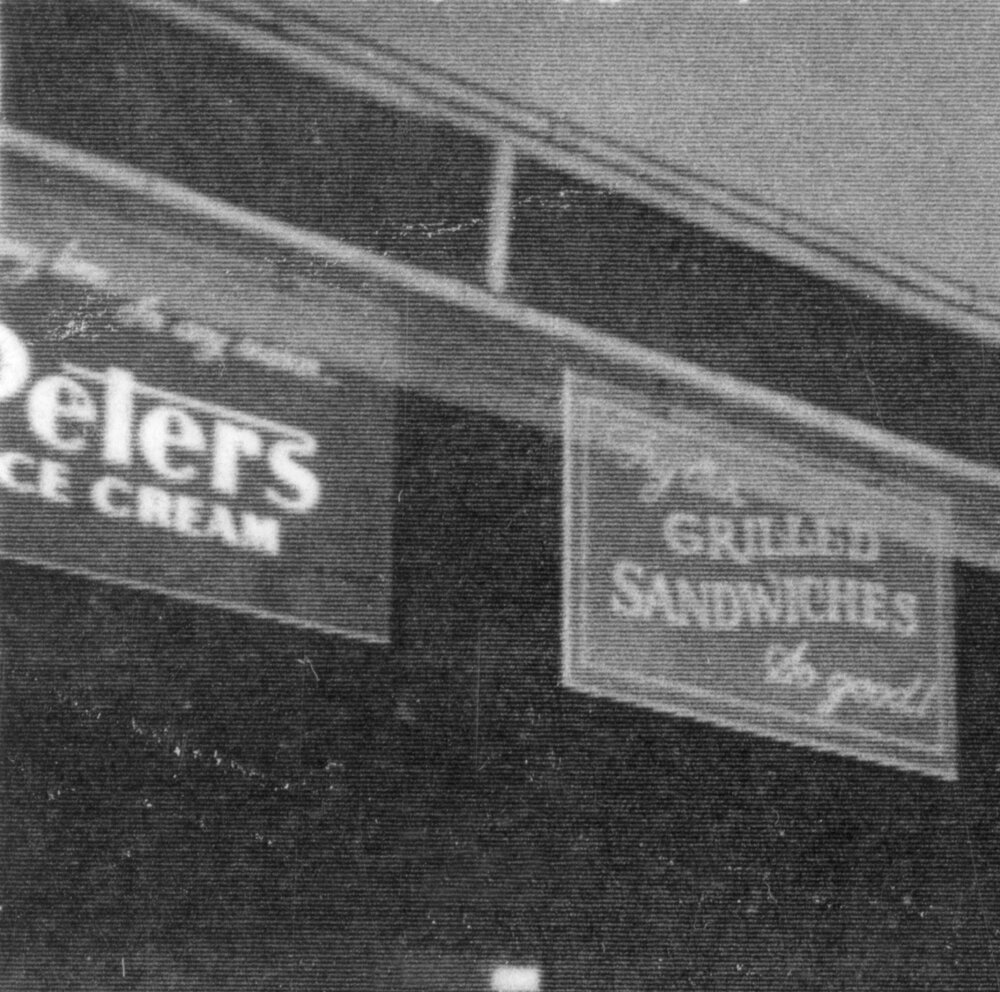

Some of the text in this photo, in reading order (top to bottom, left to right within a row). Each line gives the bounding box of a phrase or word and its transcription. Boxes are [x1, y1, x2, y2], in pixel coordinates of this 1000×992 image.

[0, 450, 282, 557] CE CREAM
[662, 512, 882, 564] GRILLED
[611, 559, 920, 637] SANDWICHES
